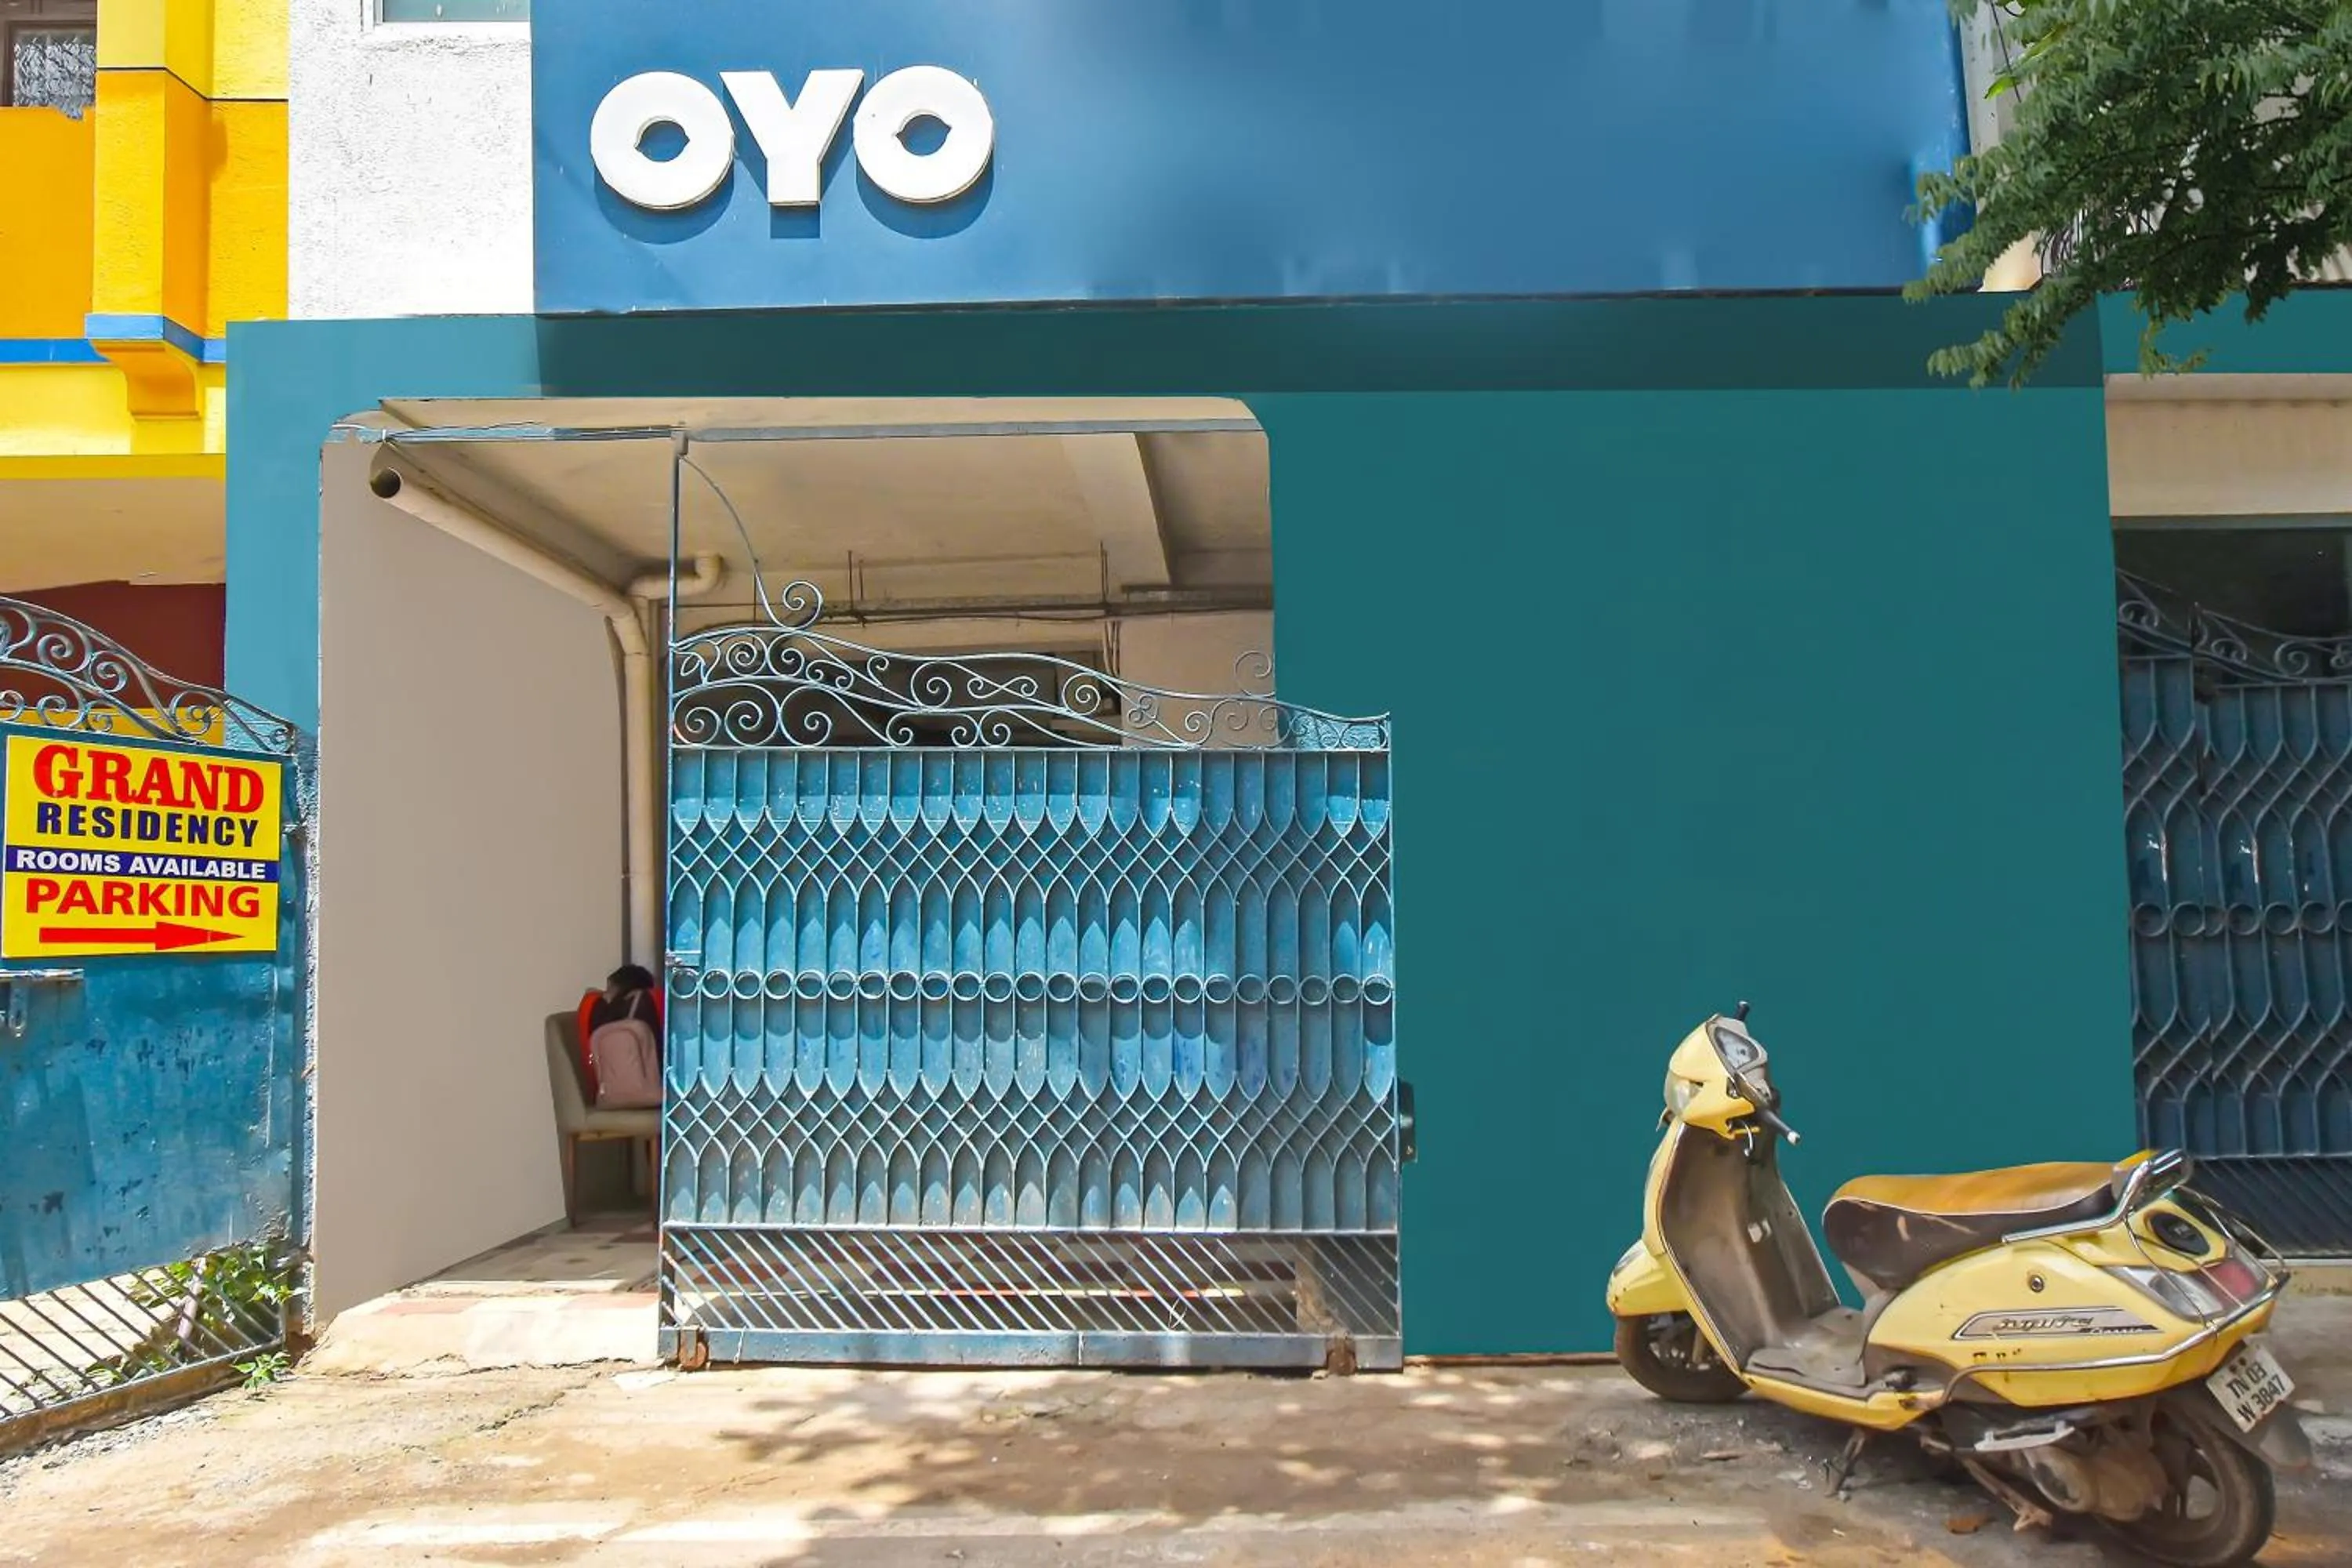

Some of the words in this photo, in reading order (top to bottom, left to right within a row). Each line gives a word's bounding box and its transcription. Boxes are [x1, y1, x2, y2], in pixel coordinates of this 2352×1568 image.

[590, 64, 994, 211] OYO
[34, 744, 264, 814] GRAND
[37, 802, 258, 848] RESIDENCY
[16, 849, 121, 873] ROOMS
[129, 857, 266, 879] AVAILABLE
[26, 878, 260, 918] PARKING
[2226, 1378, 2250, 1399] TN
[2245, 1362, 2267, 1384] 03
[2251, 1374, 2285, 1411] 3847
